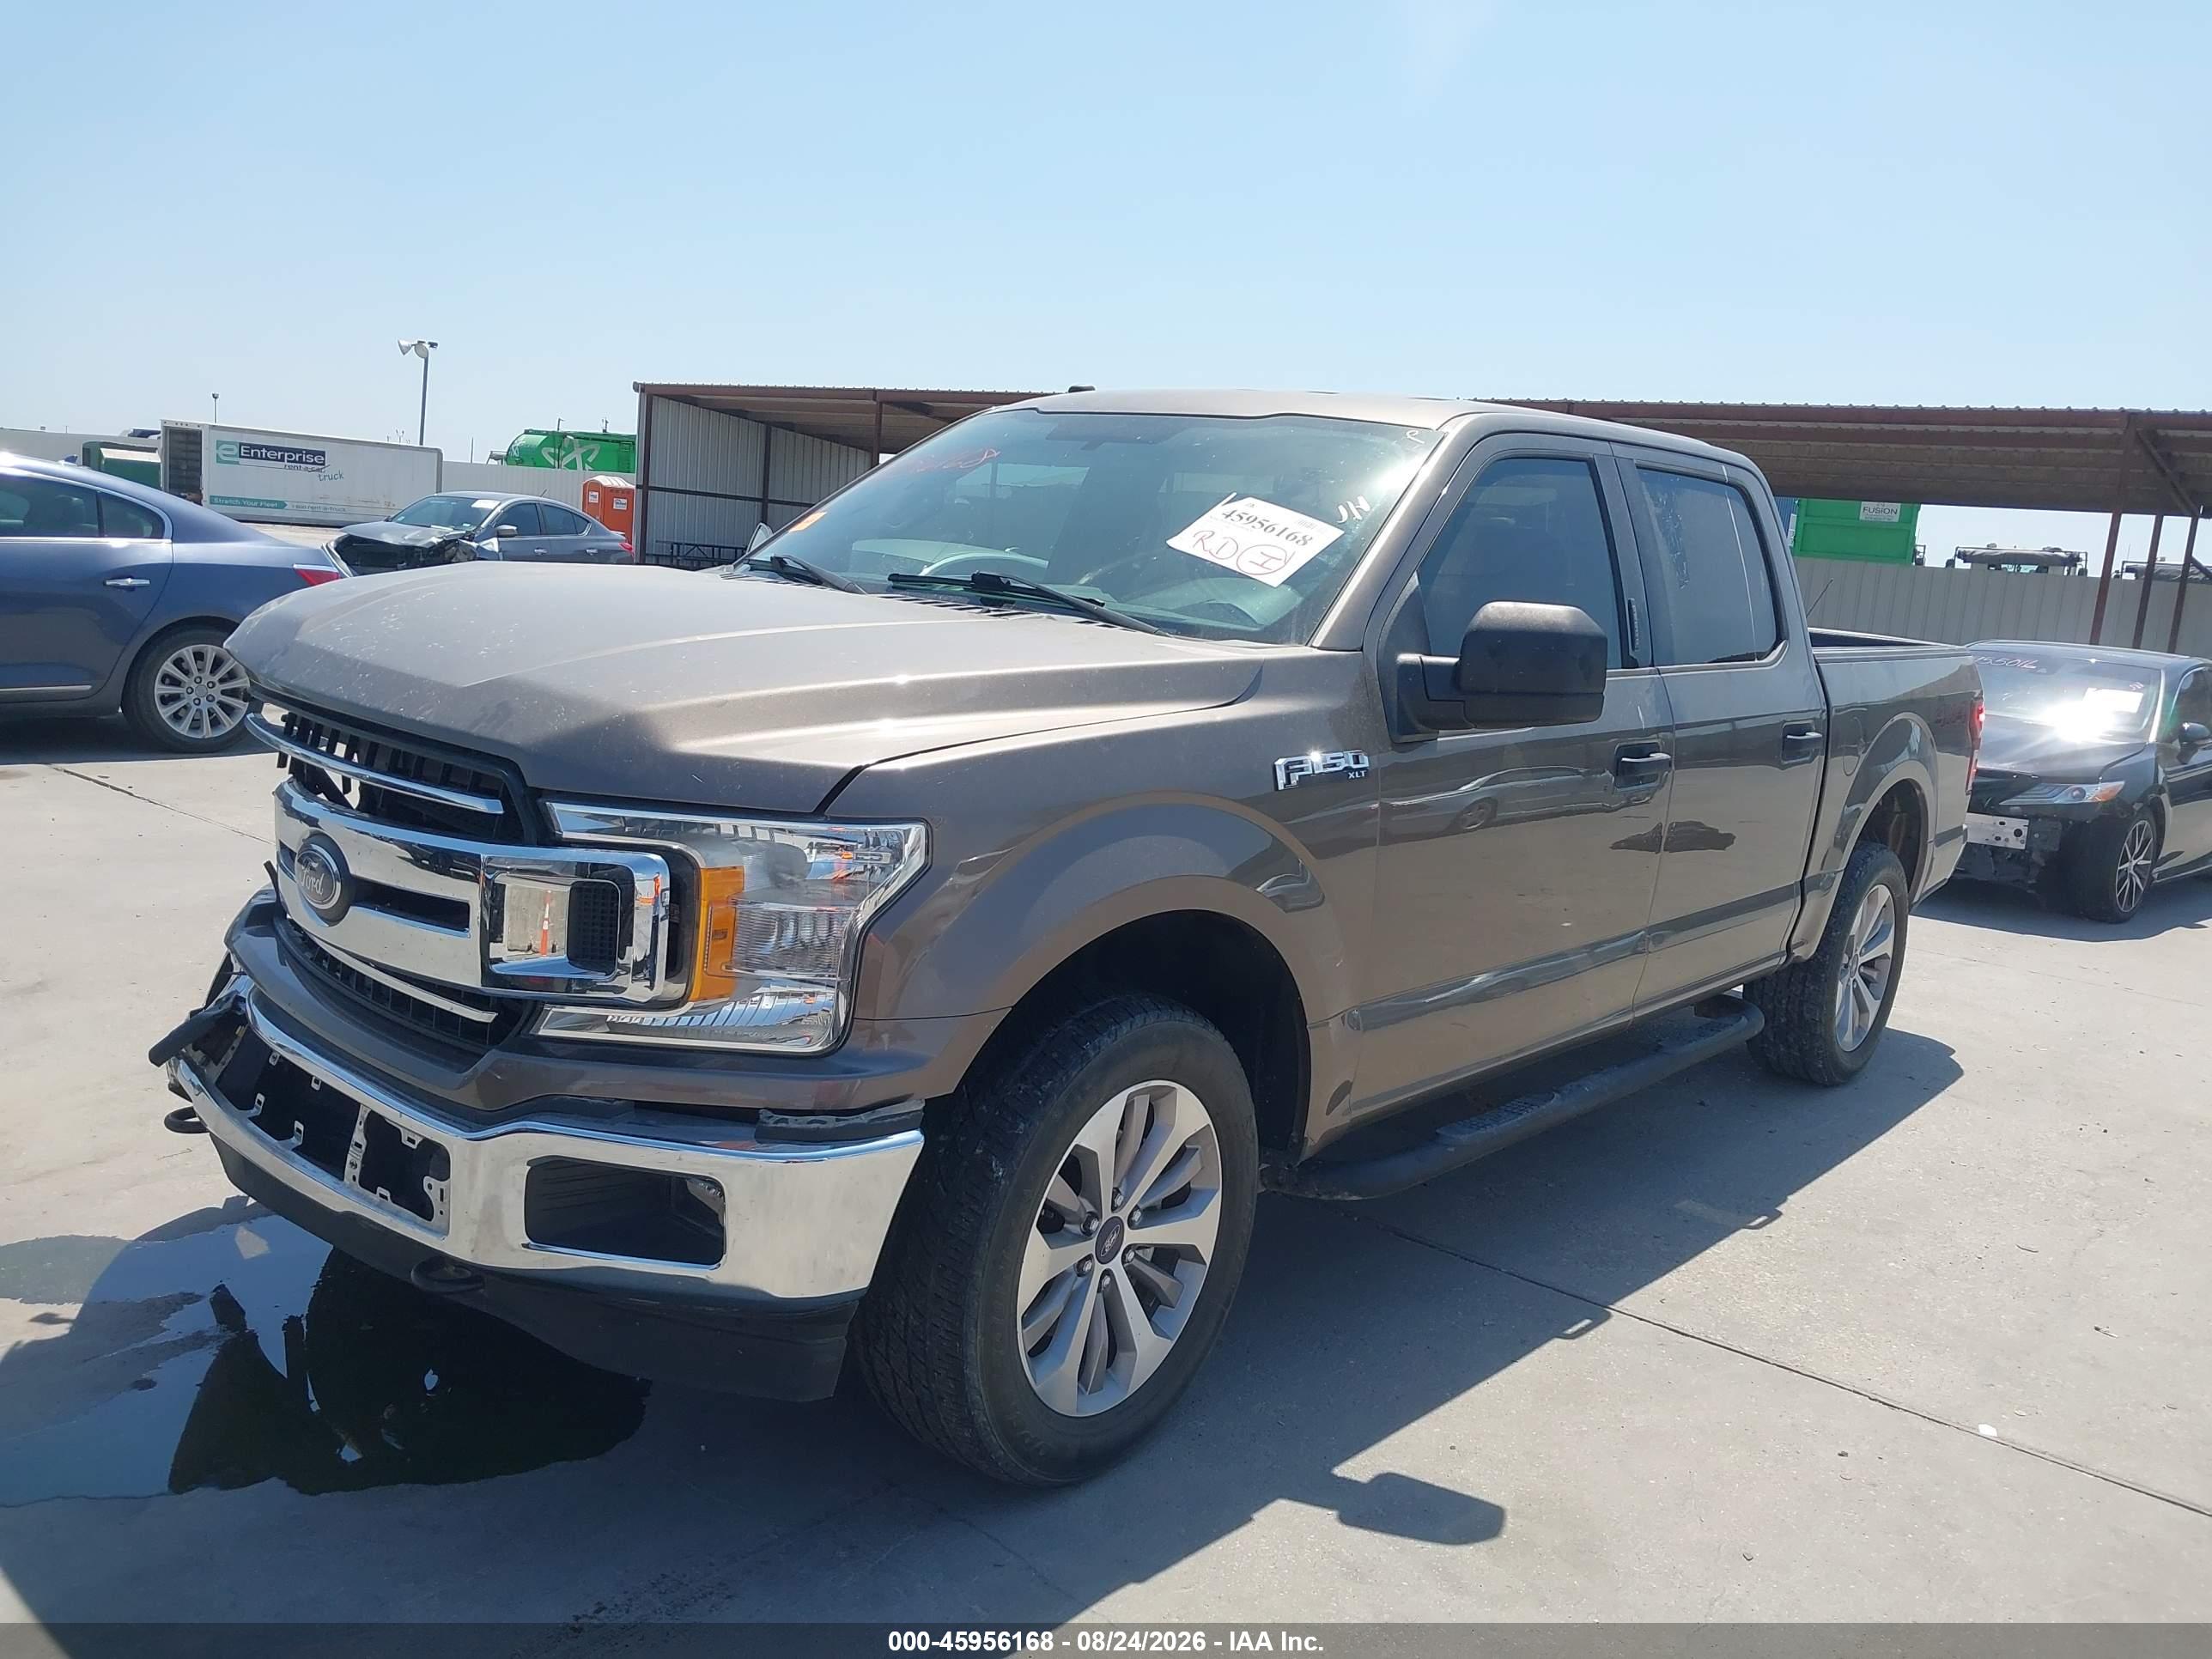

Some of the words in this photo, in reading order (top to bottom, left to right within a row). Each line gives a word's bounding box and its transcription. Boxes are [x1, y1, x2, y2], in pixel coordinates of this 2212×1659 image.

[240, 445, 325, 464] Enterprise
[318, 471, 344, 482] truck
[243, 499, 258, 507] Your
[1863, 506, 1898, 515] FUSION
[1221, 508, 1314, 547] 45956168
[1348, 770, 1366, 780] XLT
[301, 864, 325, 895] Ford
